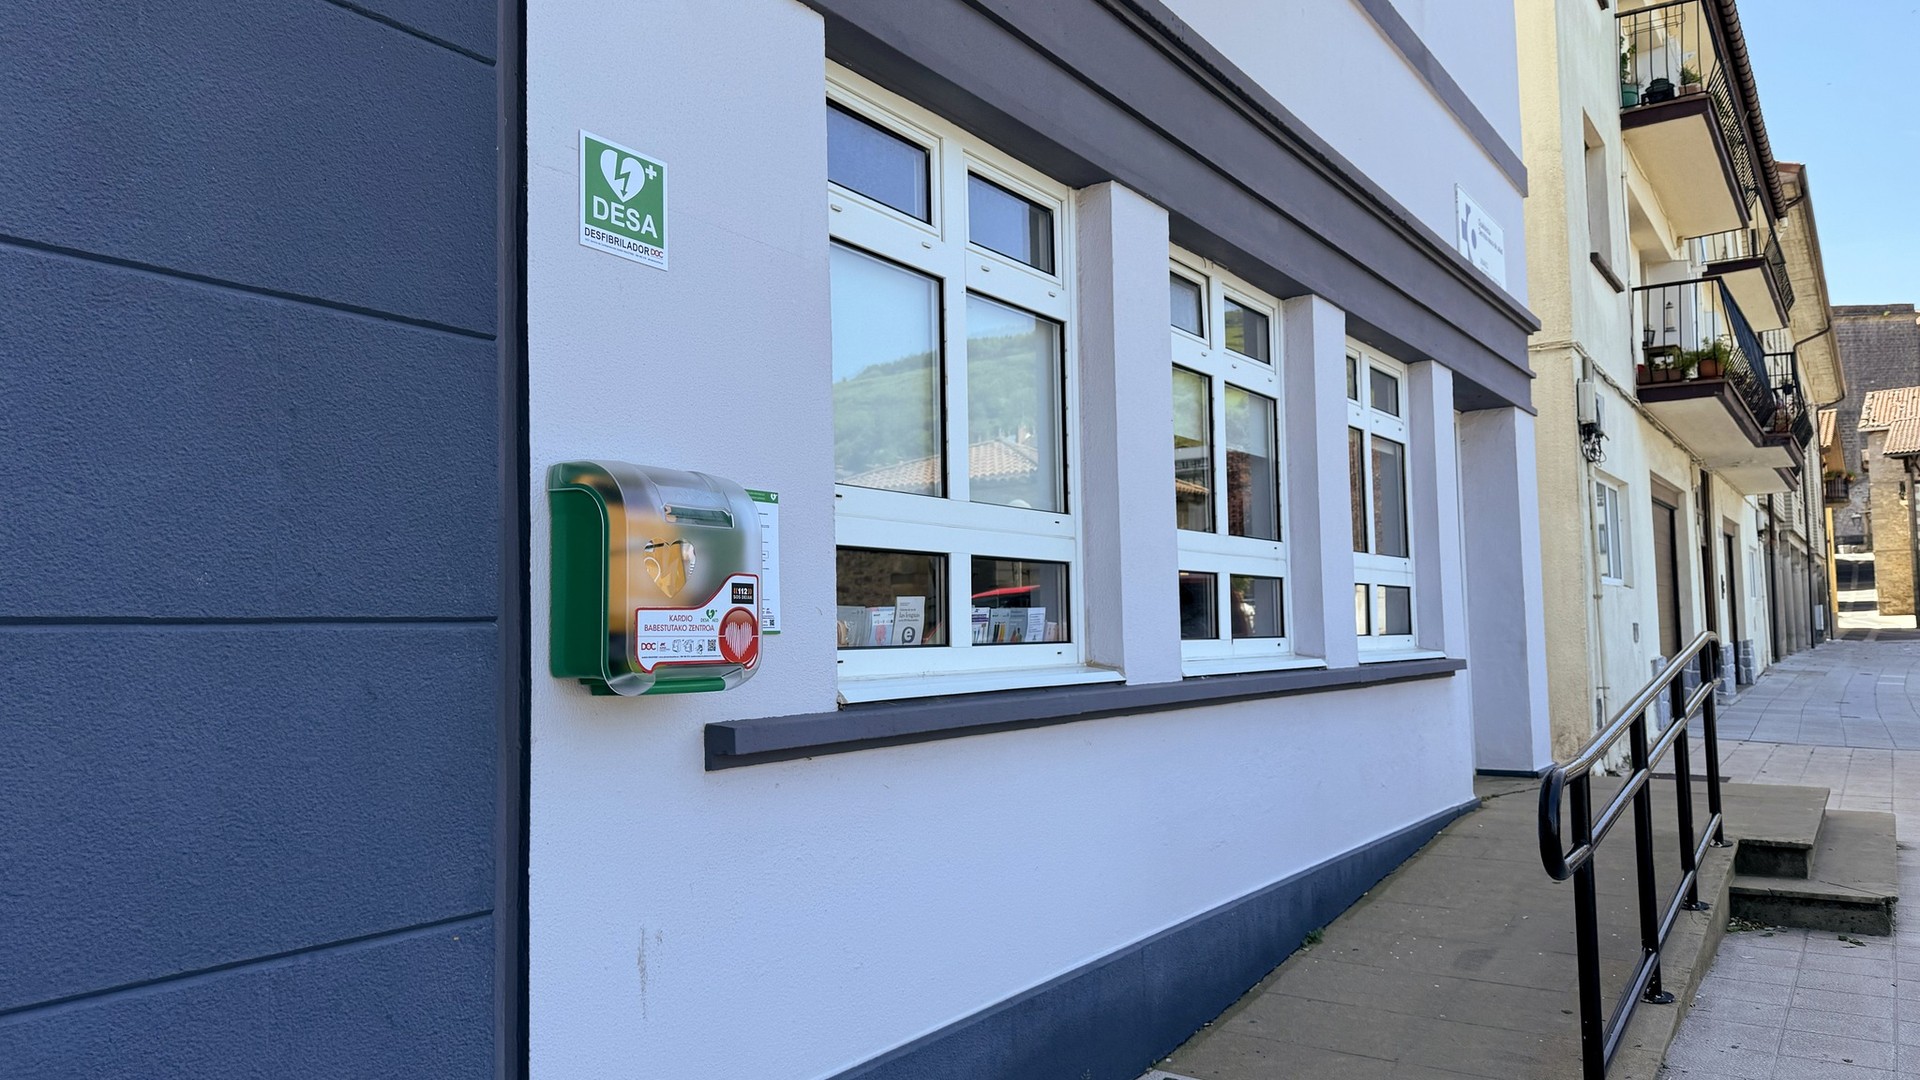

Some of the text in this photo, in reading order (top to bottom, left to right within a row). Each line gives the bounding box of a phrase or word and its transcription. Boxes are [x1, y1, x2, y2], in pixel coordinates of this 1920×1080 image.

[592, 195, 658, 239] DESA
[584, 227, 650, 256] DESFIBRILADOR
[737, 587, 748, 595] 112
[668, 614, 693, 623] KARDIO
[644, 624, 715, 632] BABESTUTAKO ZENTROA
[641, 642, 657, 651] DOC
